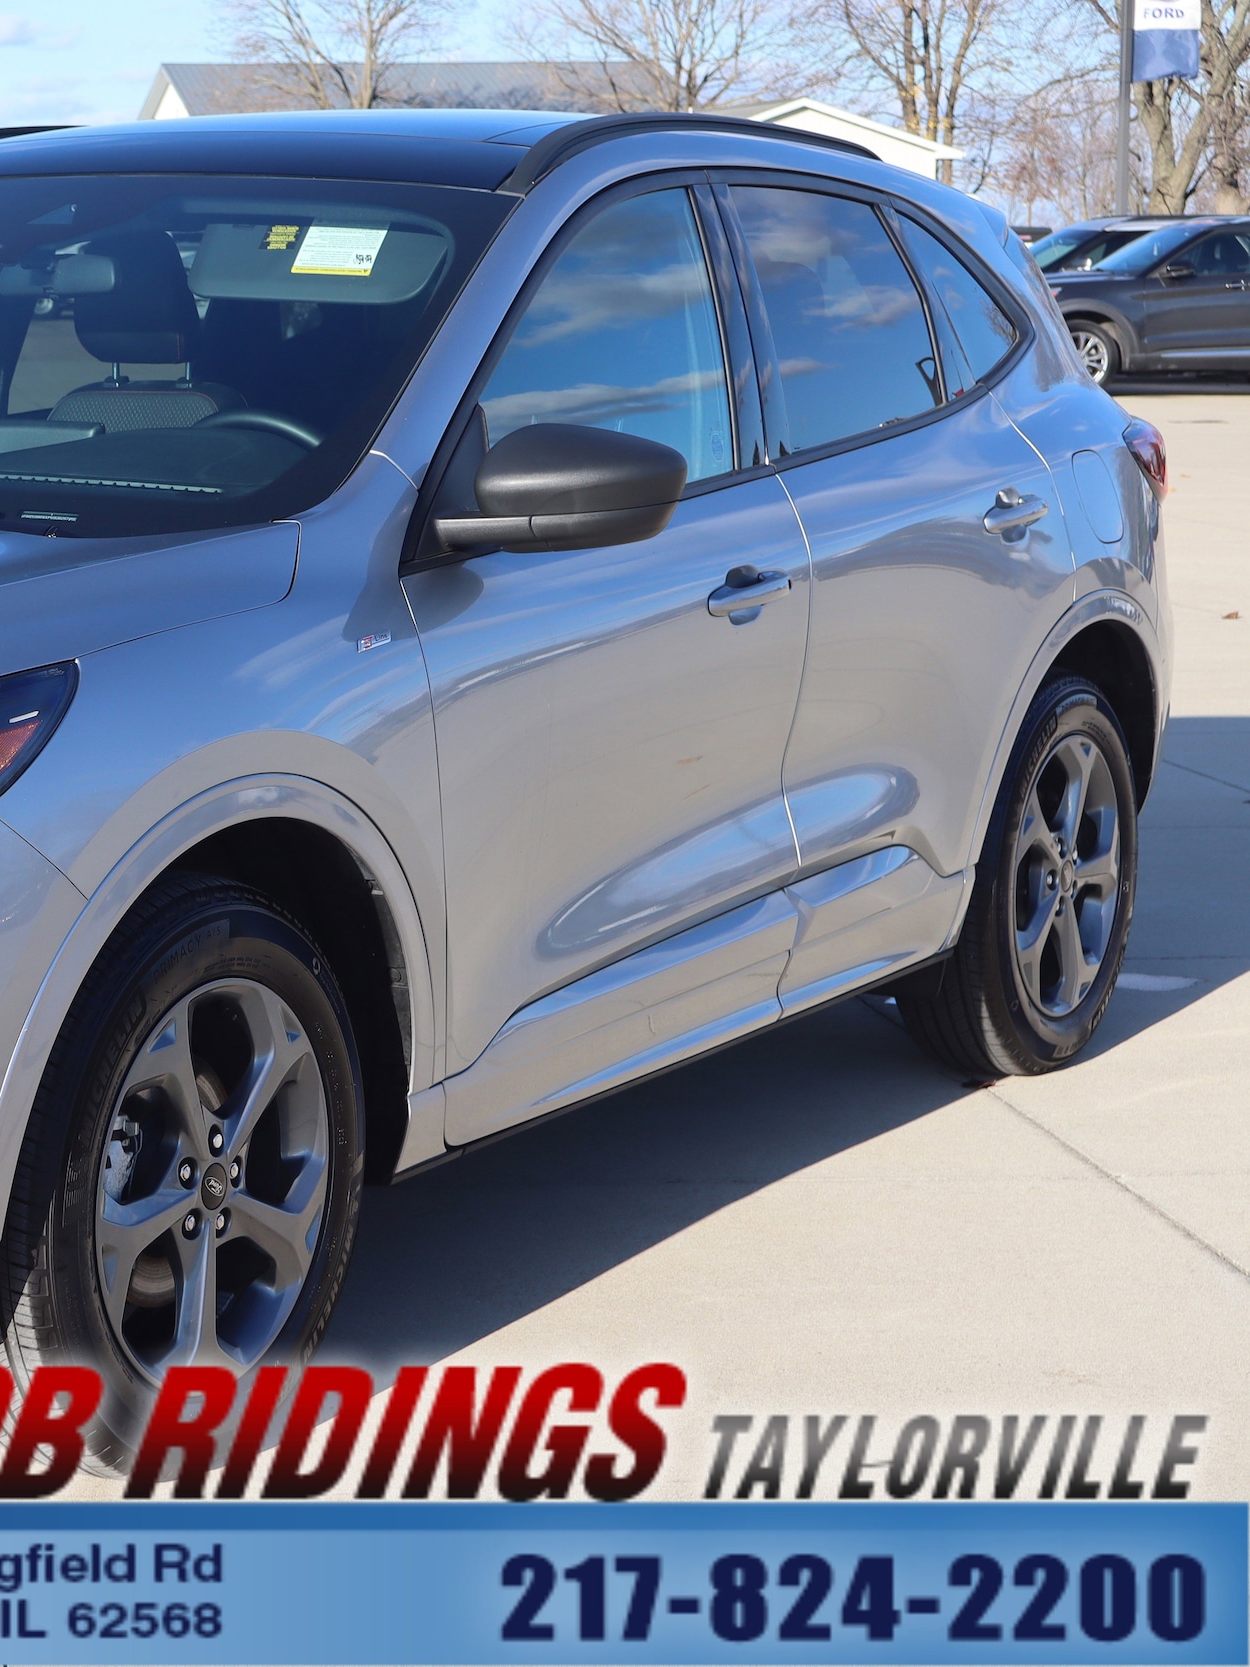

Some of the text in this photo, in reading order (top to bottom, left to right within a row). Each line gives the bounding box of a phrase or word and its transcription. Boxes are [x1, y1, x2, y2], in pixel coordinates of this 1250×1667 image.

[1143, 7, 1185, 19] FORD
[152, 935, 202, 985] PRIMACY
[303, 1225, 355, 1363] MICHELIN
